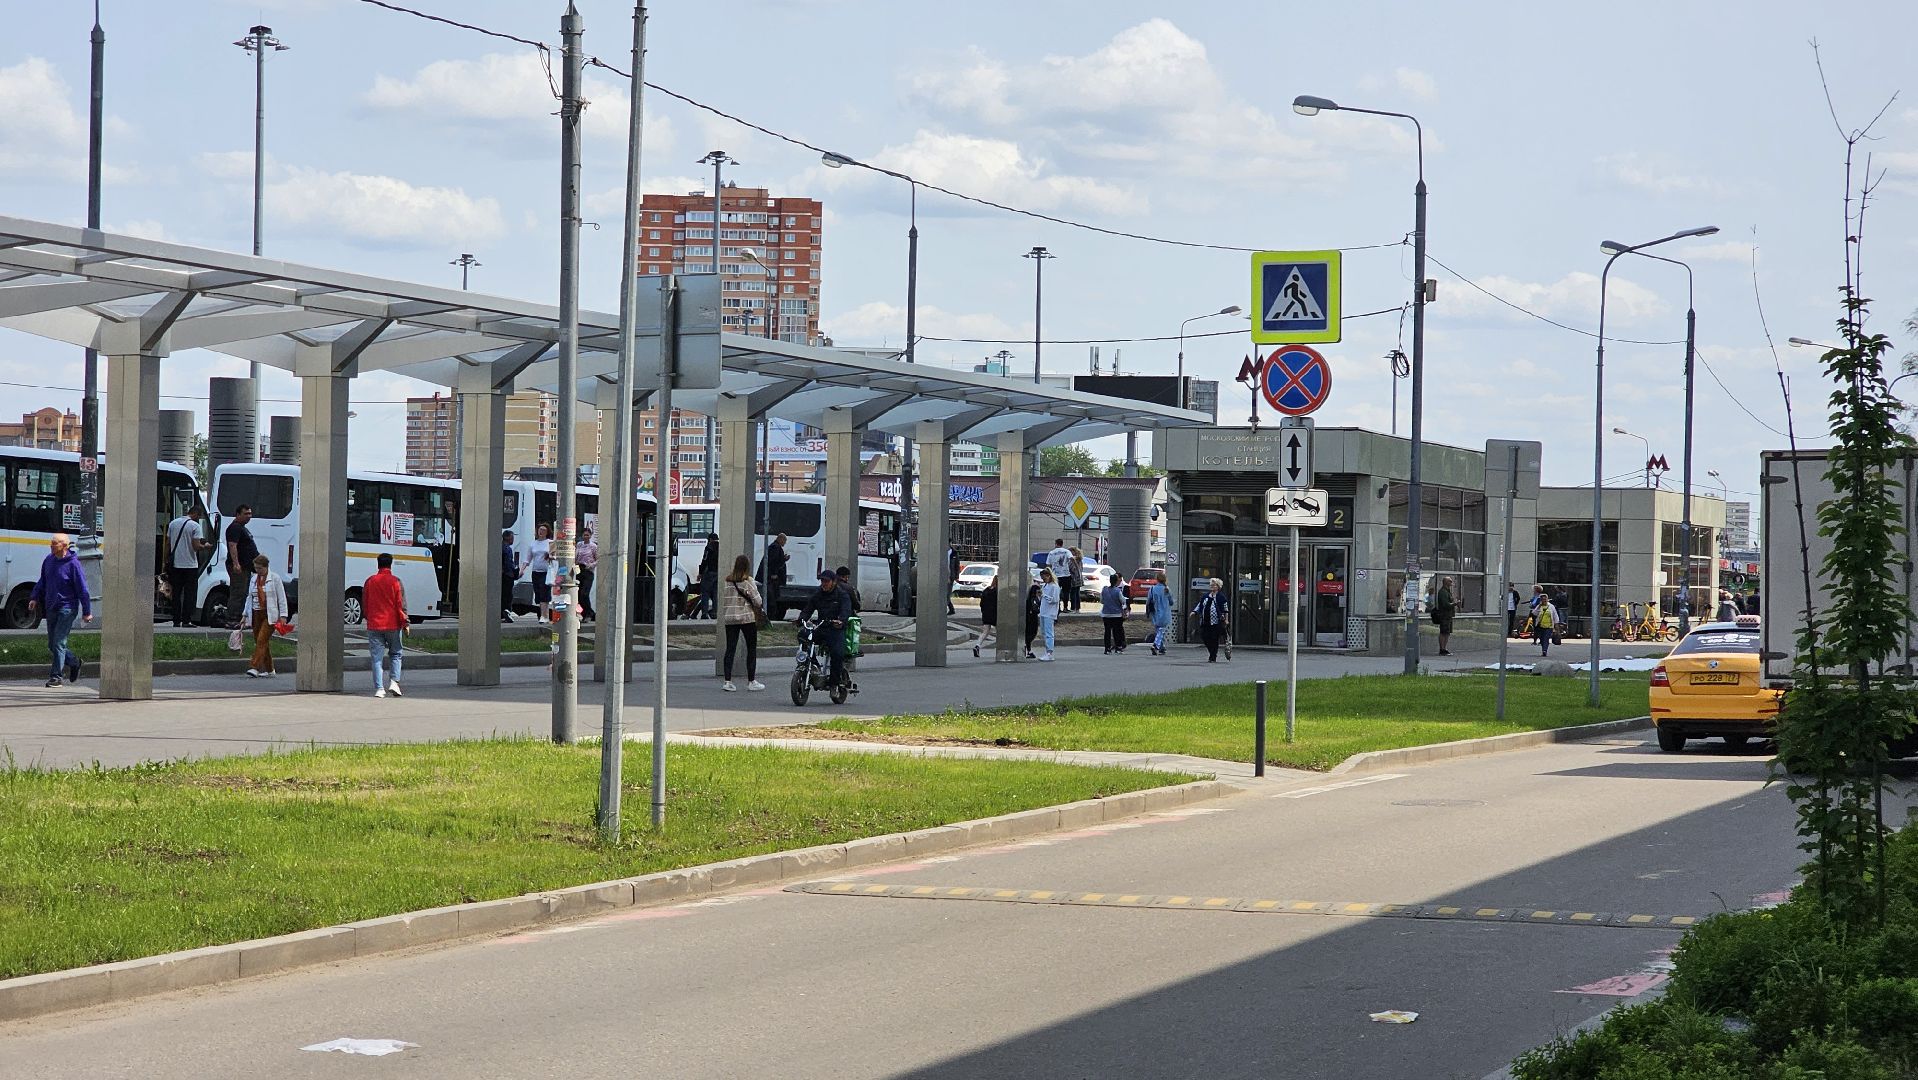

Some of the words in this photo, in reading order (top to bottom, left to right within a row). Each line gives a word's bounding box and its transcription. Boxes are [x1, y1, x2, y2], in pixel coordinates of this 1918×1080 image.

[1202, 456, 1279, 465] КОТЕЛЬН
[880, 478, 902, 502] каф
[1334, 510, 1344, 524] 2
[382, 514, 392, 540] 43
[1707, 674, 1723, 682] 228
